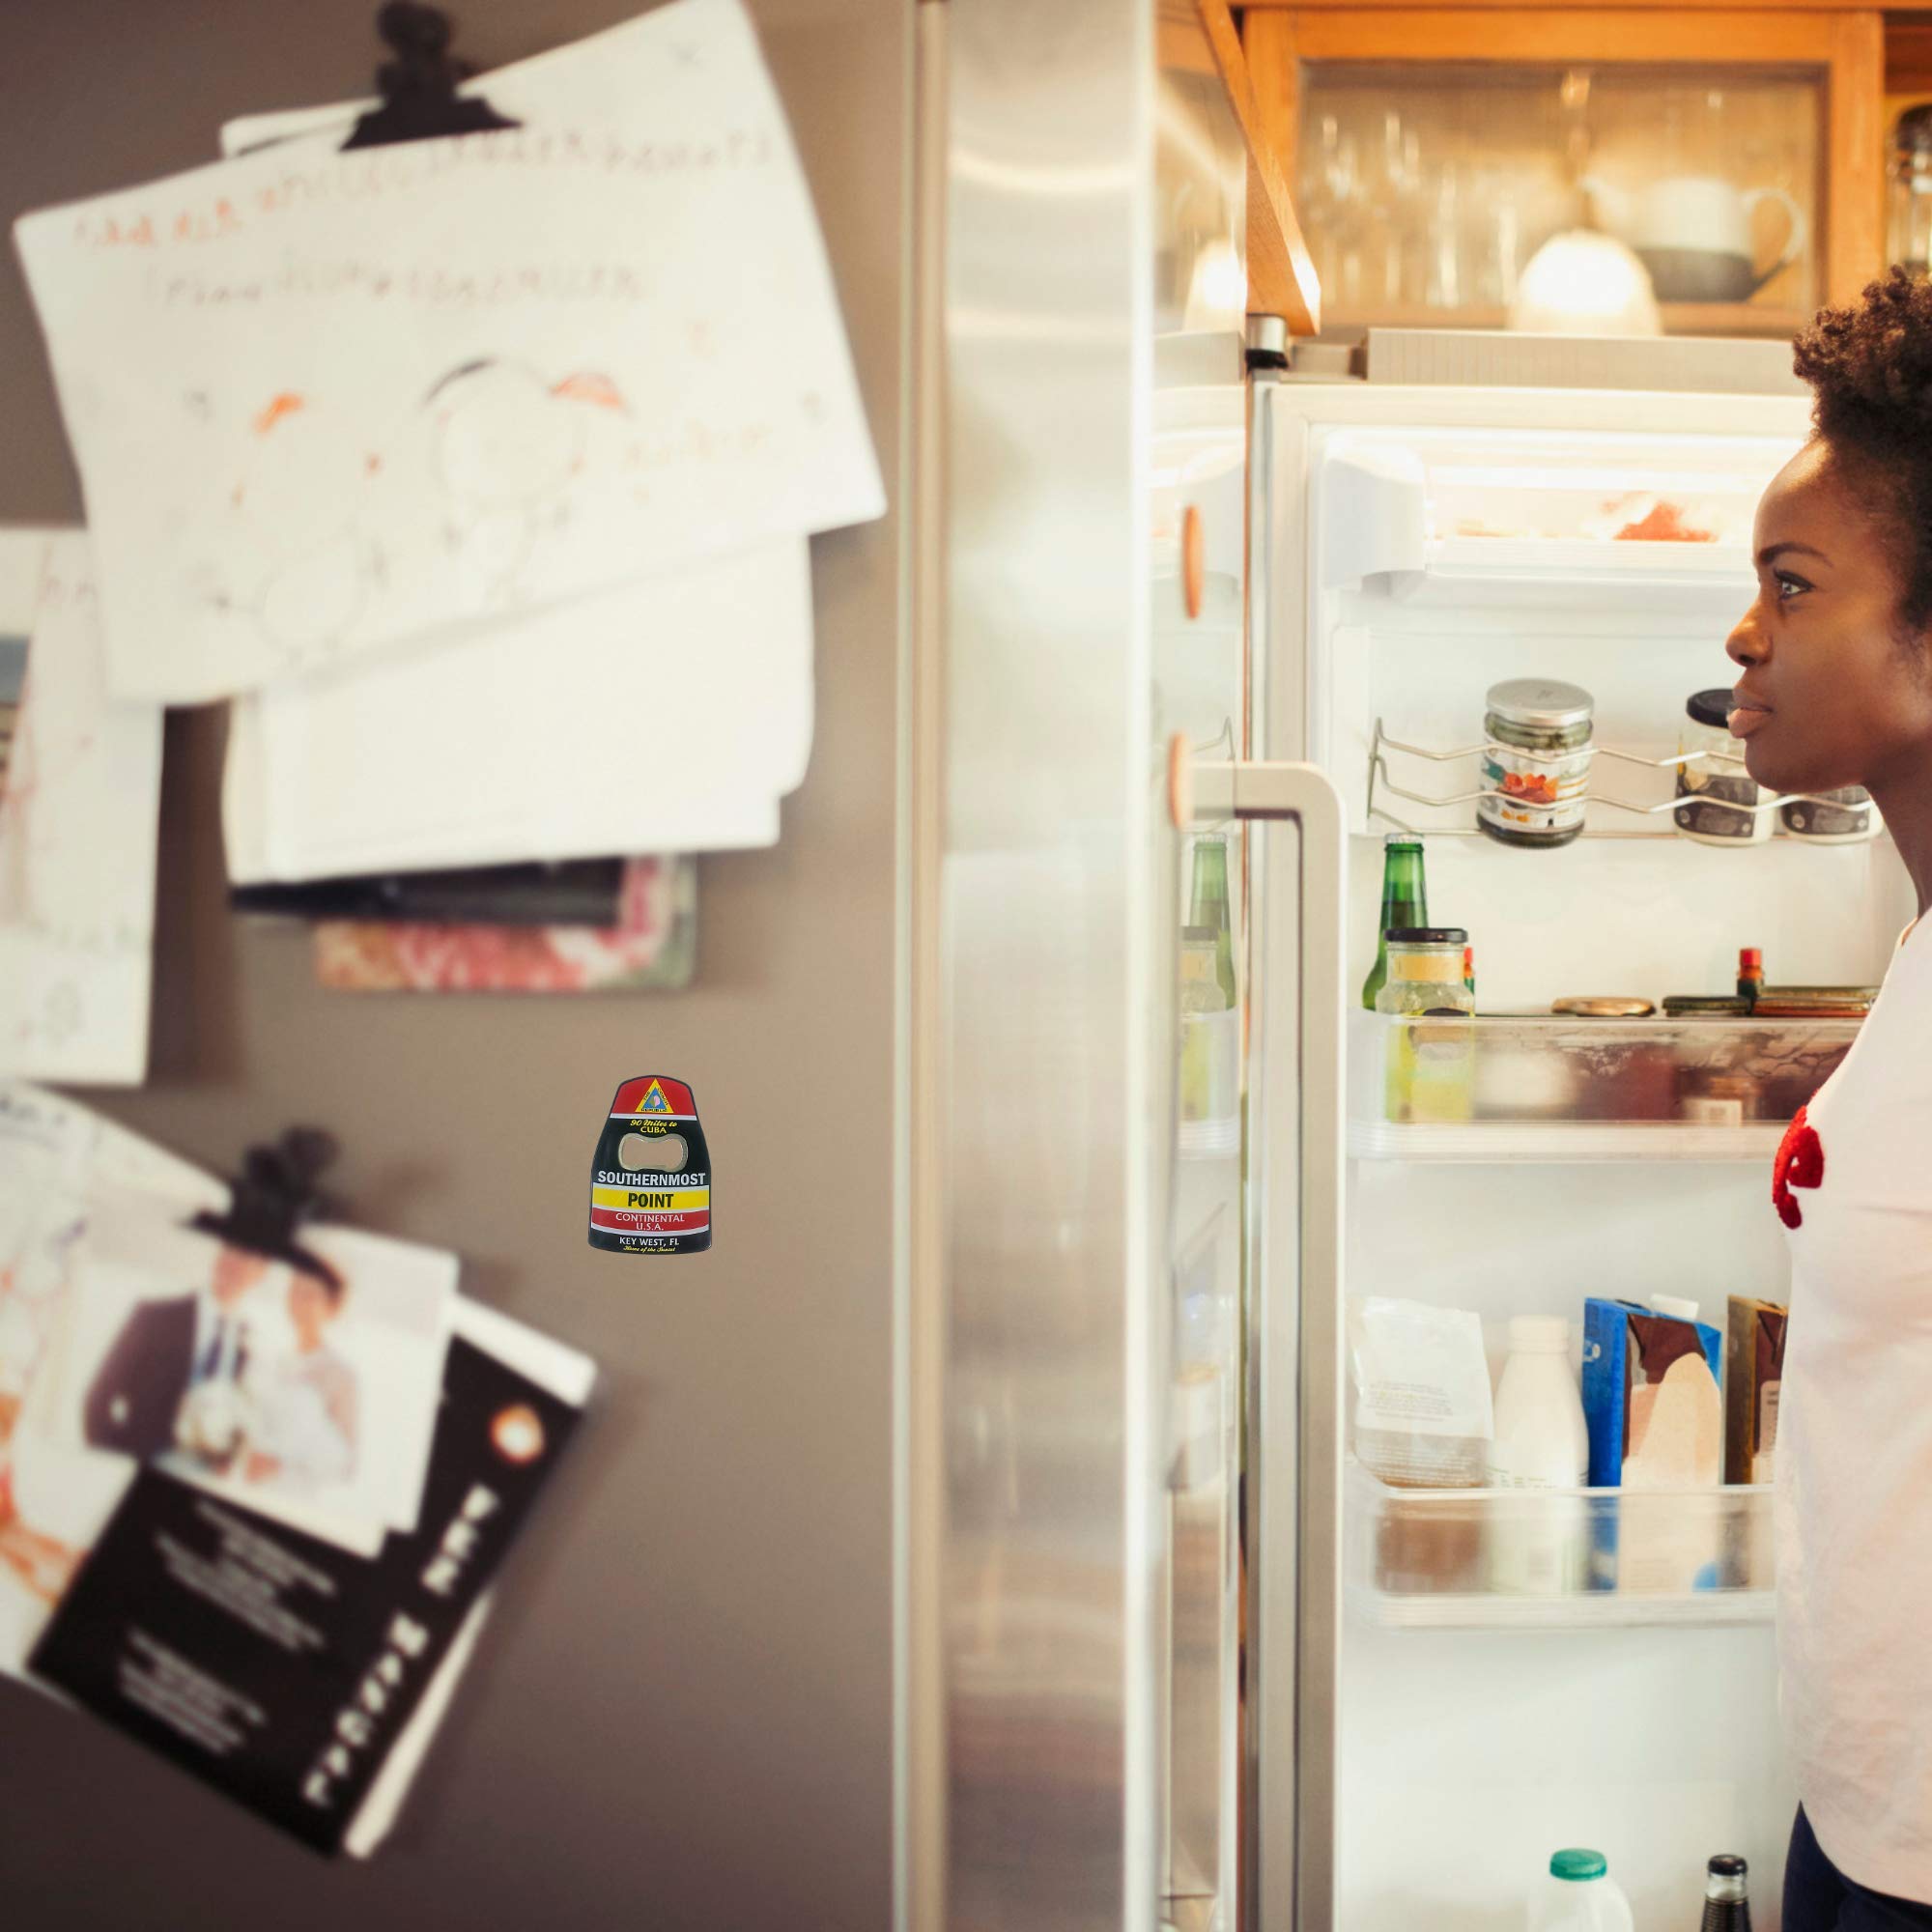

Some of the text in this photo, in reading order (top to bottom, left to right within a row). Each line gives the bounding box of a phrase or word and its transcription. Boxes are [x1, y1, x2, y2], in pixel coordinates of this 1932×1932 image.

[597, 1171, 705, 1185] SOUTHERNMOST
[628, 1193, 674, 1208] POINT
[615, 1213, 685, 1222] CONTINENTAL
[619, 1236, 637, 1245] KEY
[639, 1237, 667, 1246] WEST,
